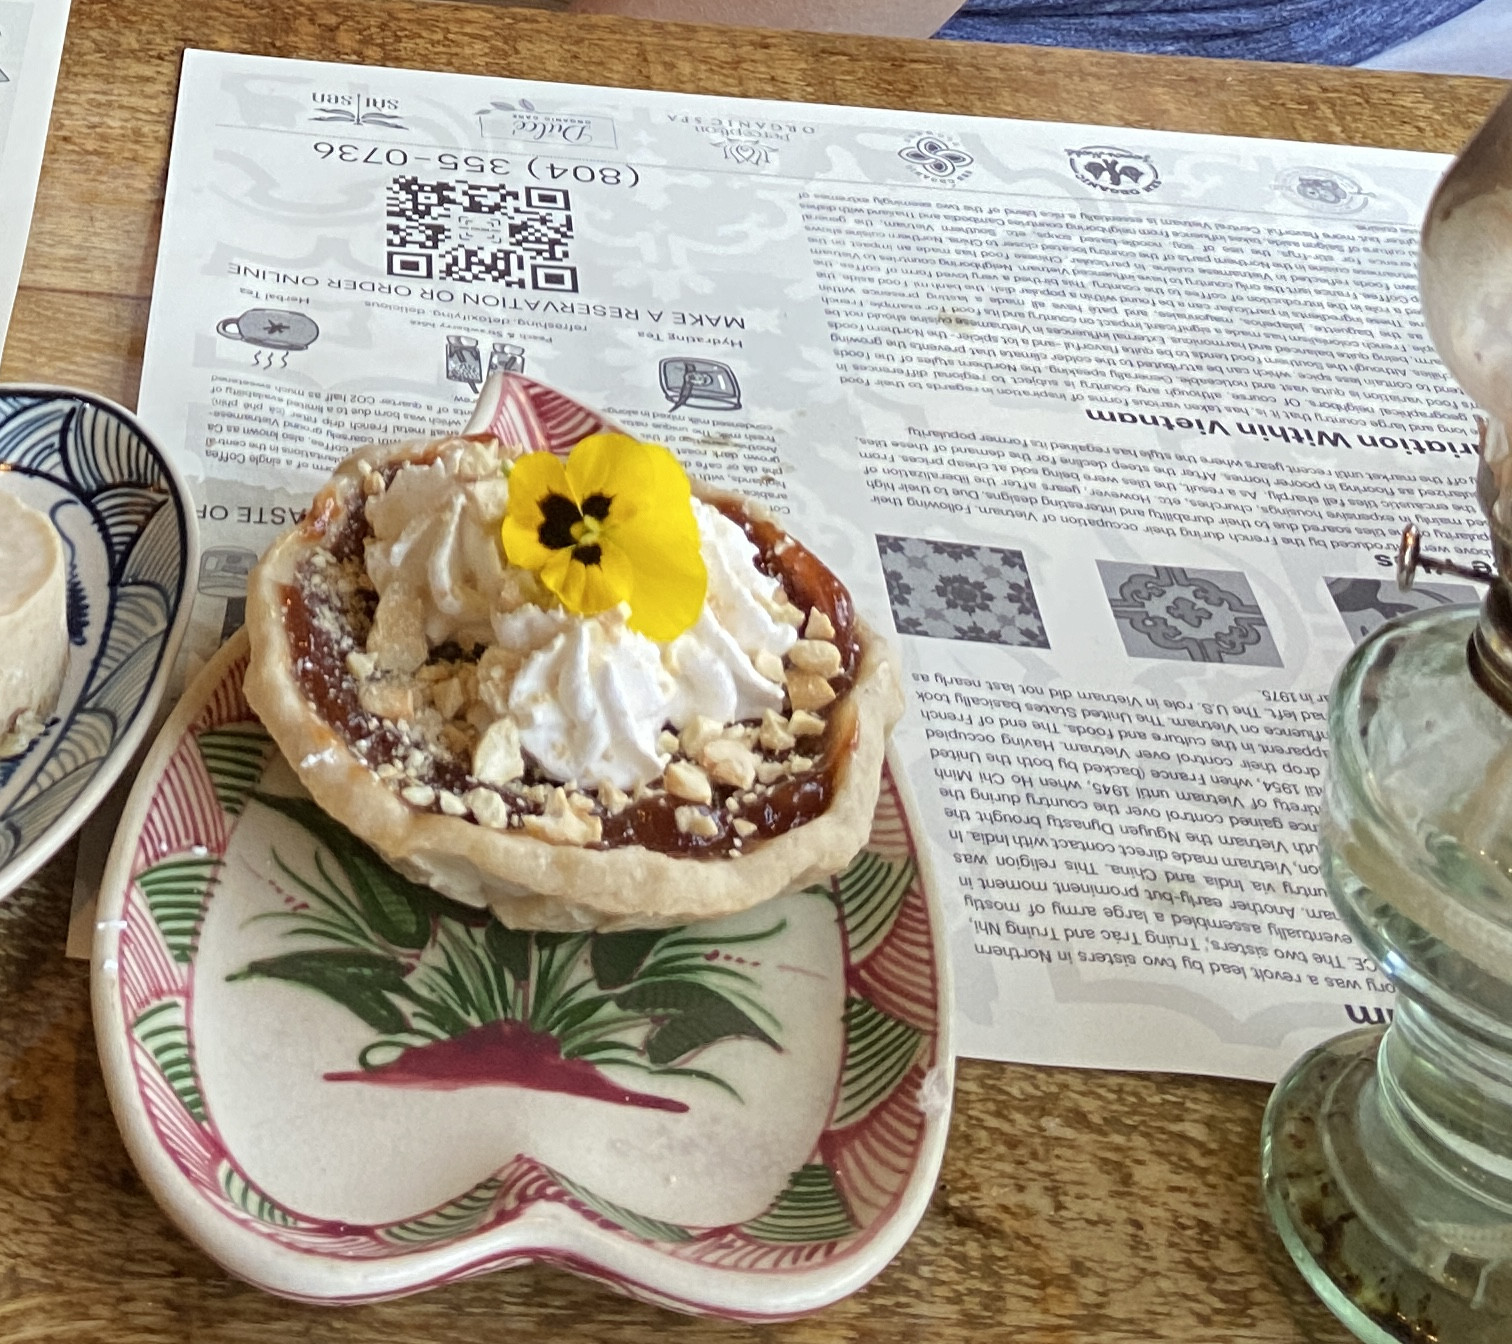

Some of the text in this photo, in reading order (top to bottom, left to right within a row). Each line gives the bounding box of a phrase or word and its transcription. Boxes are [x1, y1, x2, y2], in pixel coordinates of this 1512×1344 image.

[312, 140, 640, 189] (804) 355-0736
[226, 261, 746, 331] MAKE A RESERVATION OR ORDER ONLINE
[1084, 407, 1232, 438] Vietnam
[1234, 420, 1353, 450] Within
[236, 505, 307, 527] ASTE
[932, 766, 1269, 811] of Vietnam until 1945, when Ho Chi Minh
[947, 828, 965, 844] In
[1010, 834, 1050, 850] with
[1048, 836, 1117, 854] contact
[951, 851, 989, 866] was
[994, 852, 1058, 873] religion
[1116, 843, 1169, 863] direct
[1169, 849, 1220, 866] made
[1062, 859, 1100, 877] This
[1219, 855, 1294, 877] Vietnam
[957, 874, 975, 891] in
[975, 876, 1049, 893] moment
[1162, 869, 1197, 885] and
[1201, 874, 1246, 894] India
[1051, 880, 1141, 899] prominent
[1248, 879, 1277, 896] via
[962, 892, 1354, 945] eventually assembled a large army of mostly
[1227, 899, 1296, 920] Another
[972, 941, 1363, 991] was a revolt lead by two sisters in Northern
